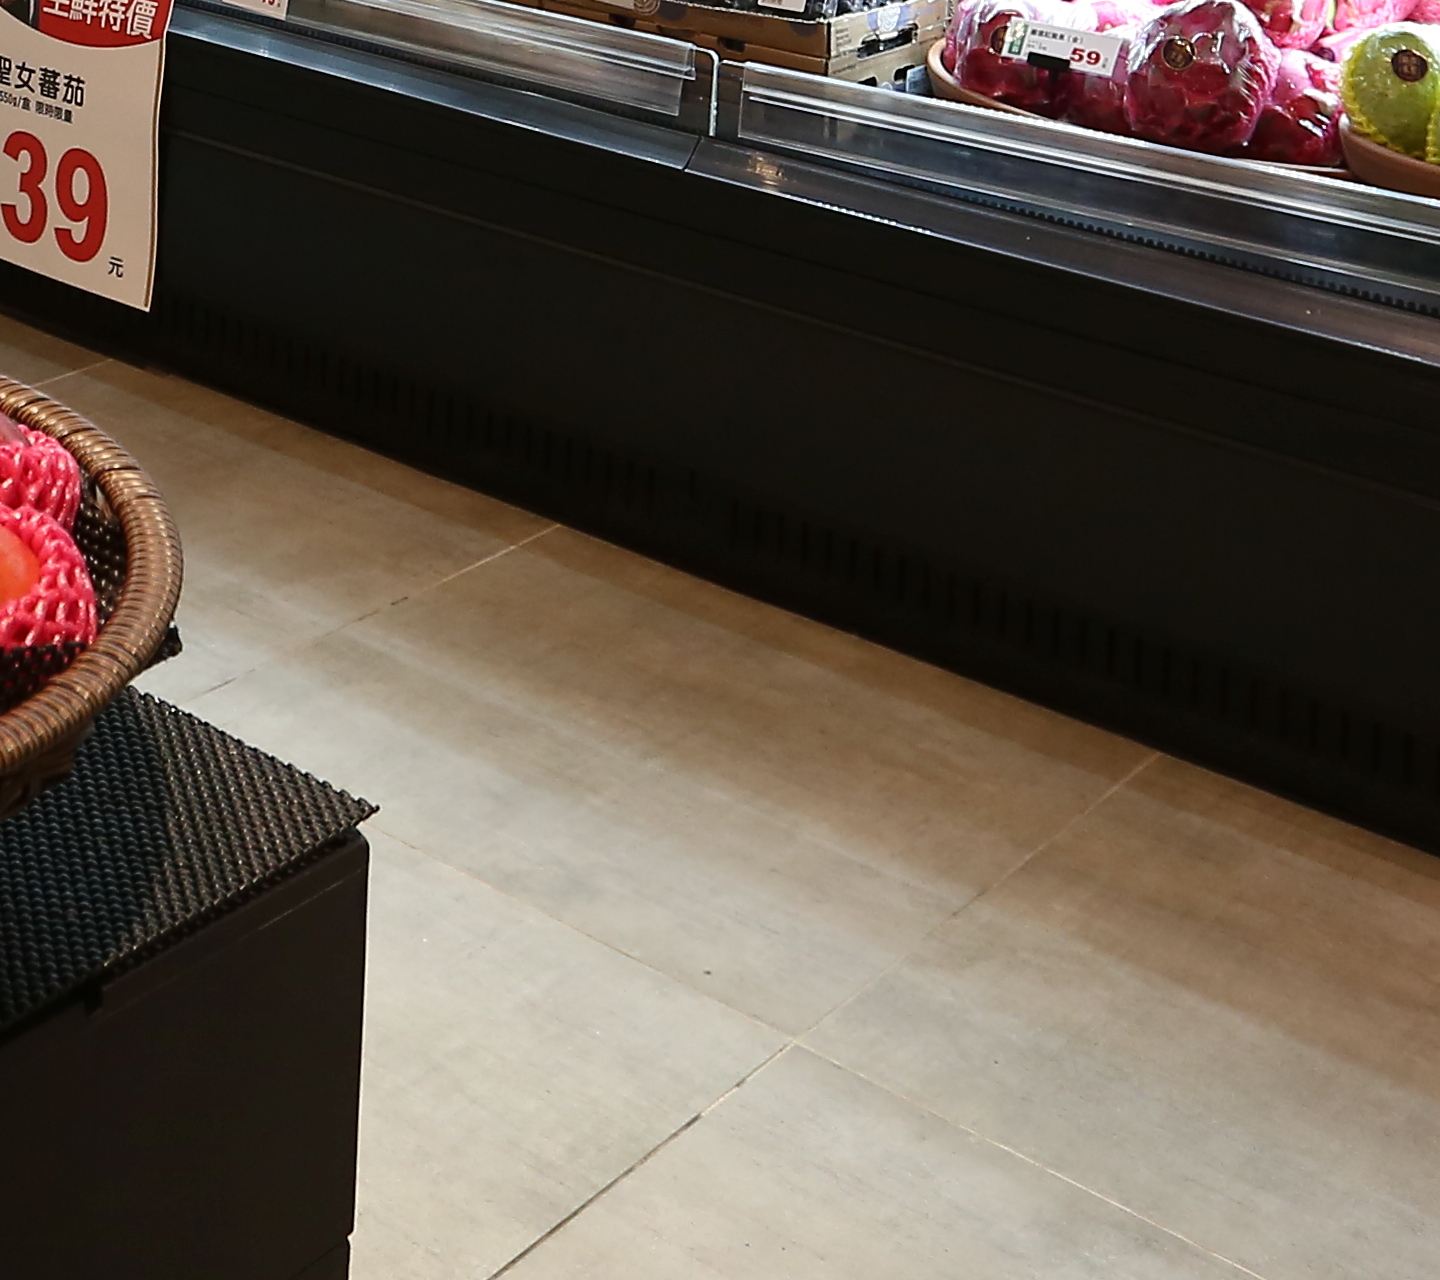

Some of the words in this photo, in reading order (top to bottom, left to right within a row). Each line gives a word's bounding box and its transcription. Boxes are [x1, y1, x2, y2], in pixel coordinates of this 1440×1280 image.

[1070, 47, 1102, 66] 59
[0, 130, 108, 264] 39
[107, 256, 125, 279] 元
